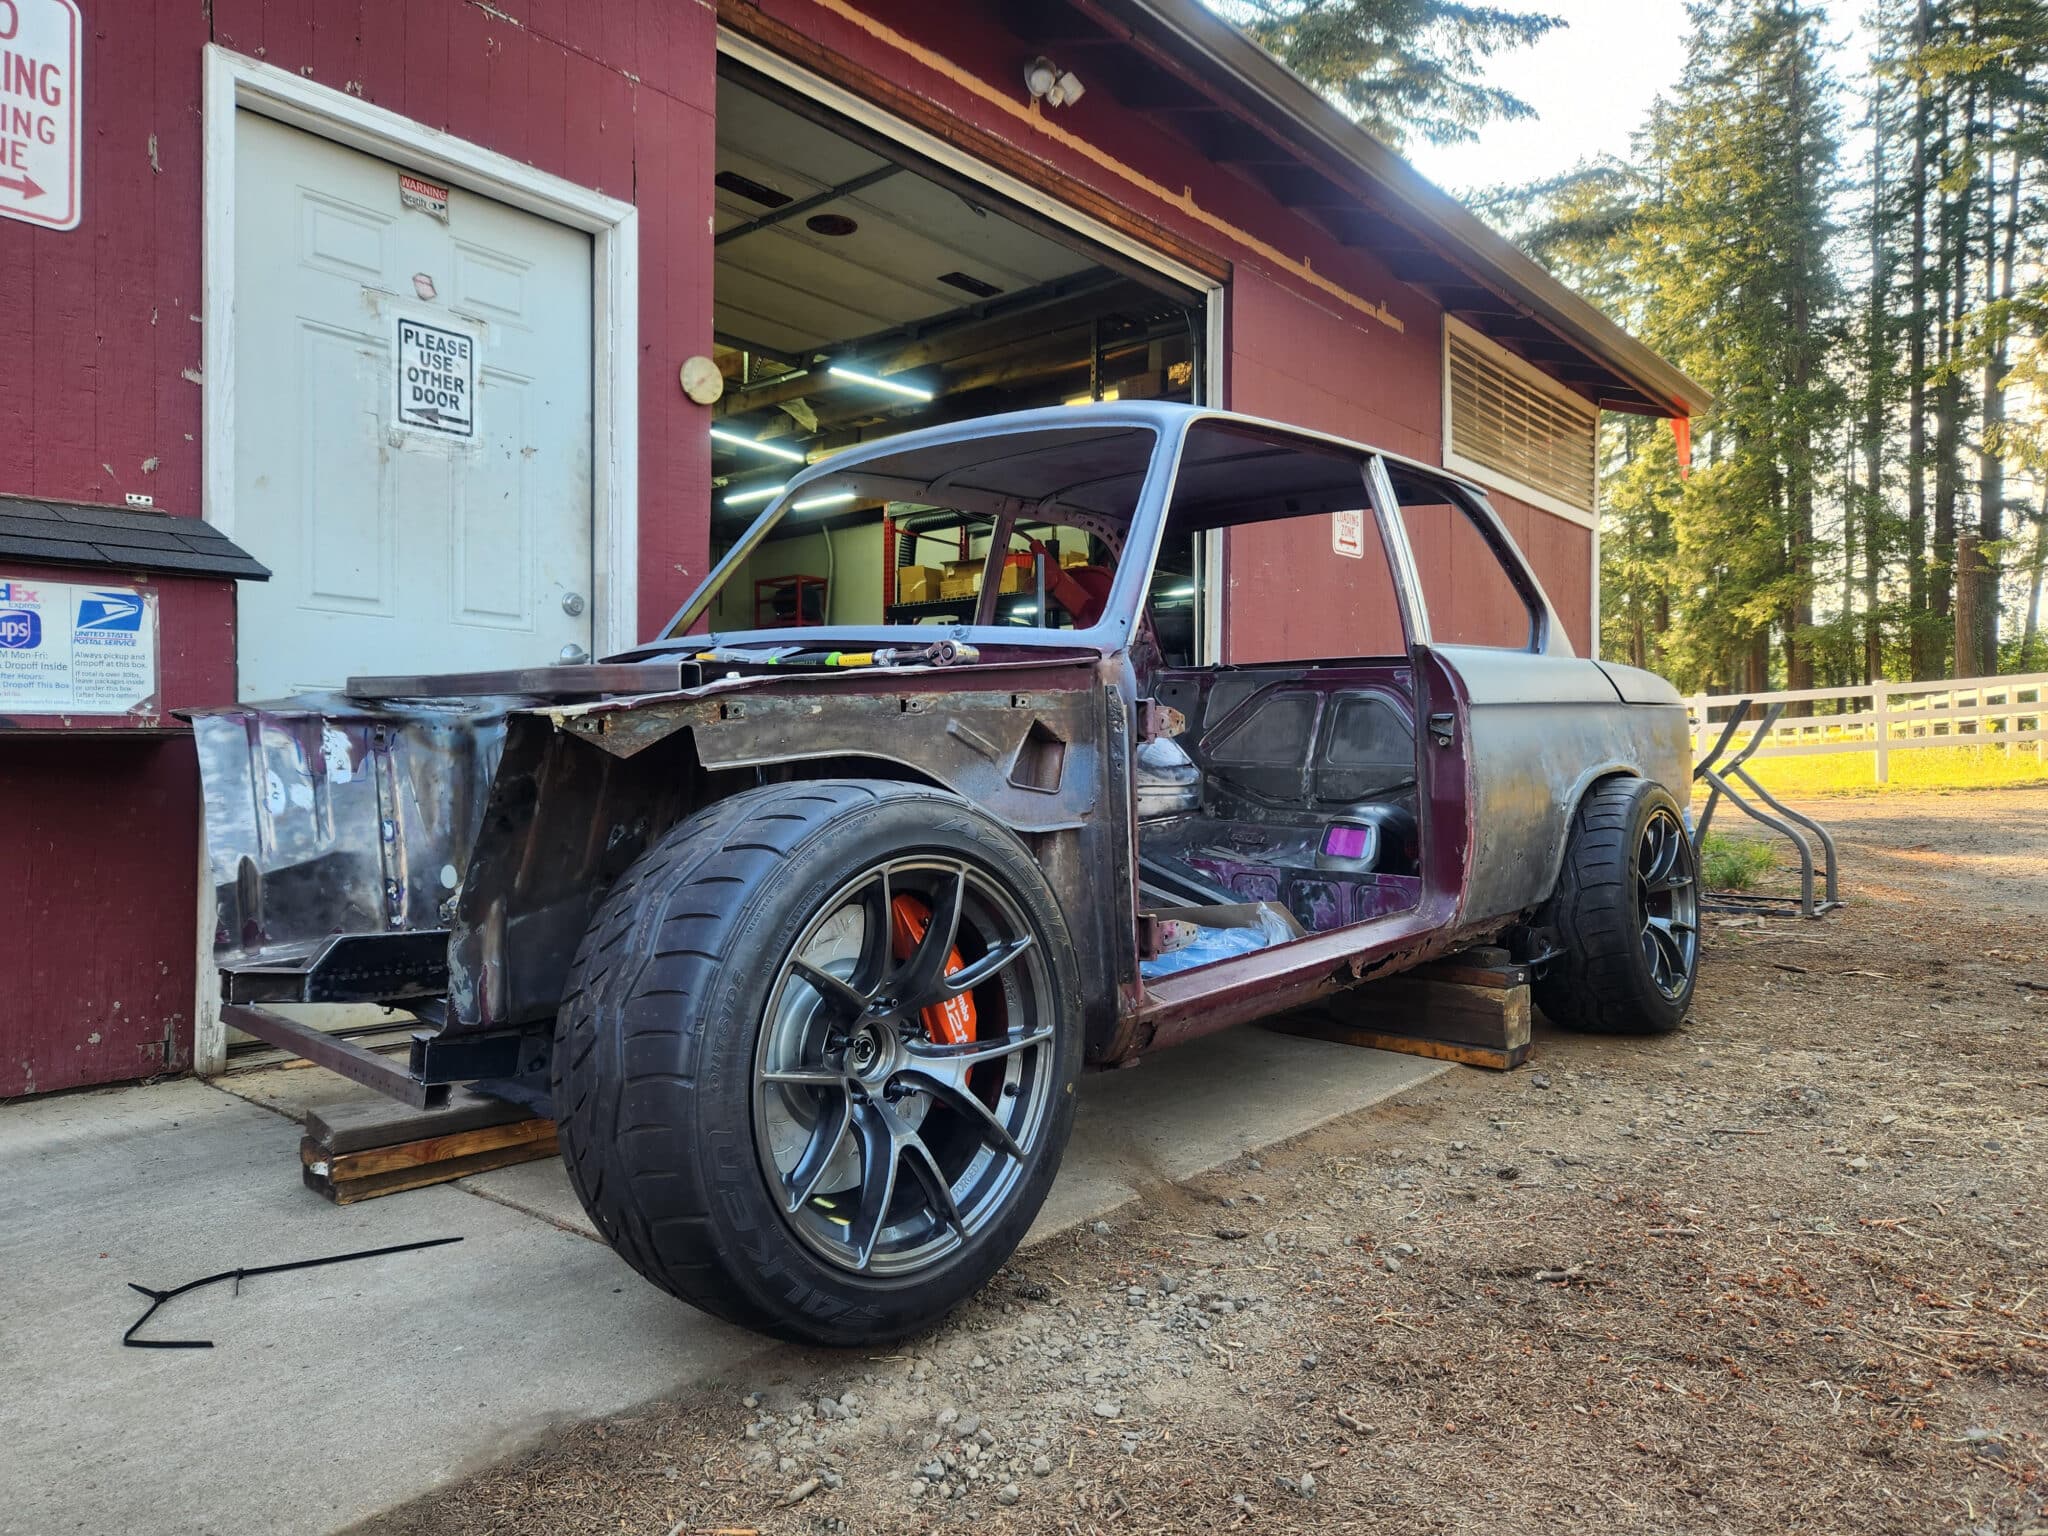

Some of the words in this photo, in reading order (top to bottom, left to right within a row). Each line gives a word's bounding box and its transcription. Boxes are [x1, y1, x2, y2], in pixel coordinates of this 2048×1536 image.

[0, 0, 19, 40] O
[401, 175, 447, 201] WARNING
[403, 327, 468, 360] PLEASE
[420, 349, 453, 374] USE
[407, 366, 465, 394] OTHER
[412, 385, 460, 411] DOOR
[0, 583, 39, 602] dEx
[104, 639, 137, 647] SERVICE
[5, 661, 38, 670] Dropoff
[41, 662, 68, 671] Inside
[75, 652, 102, 661] Always
[103, 653, 129, 661] pickup
[75, 660, 104, 668] dropoff
[2, 681, 34, 689] Dropoff
[709, 967, 745, 1093] OUTSIDE
[706, 1129, 886, 1324] FALKEN
